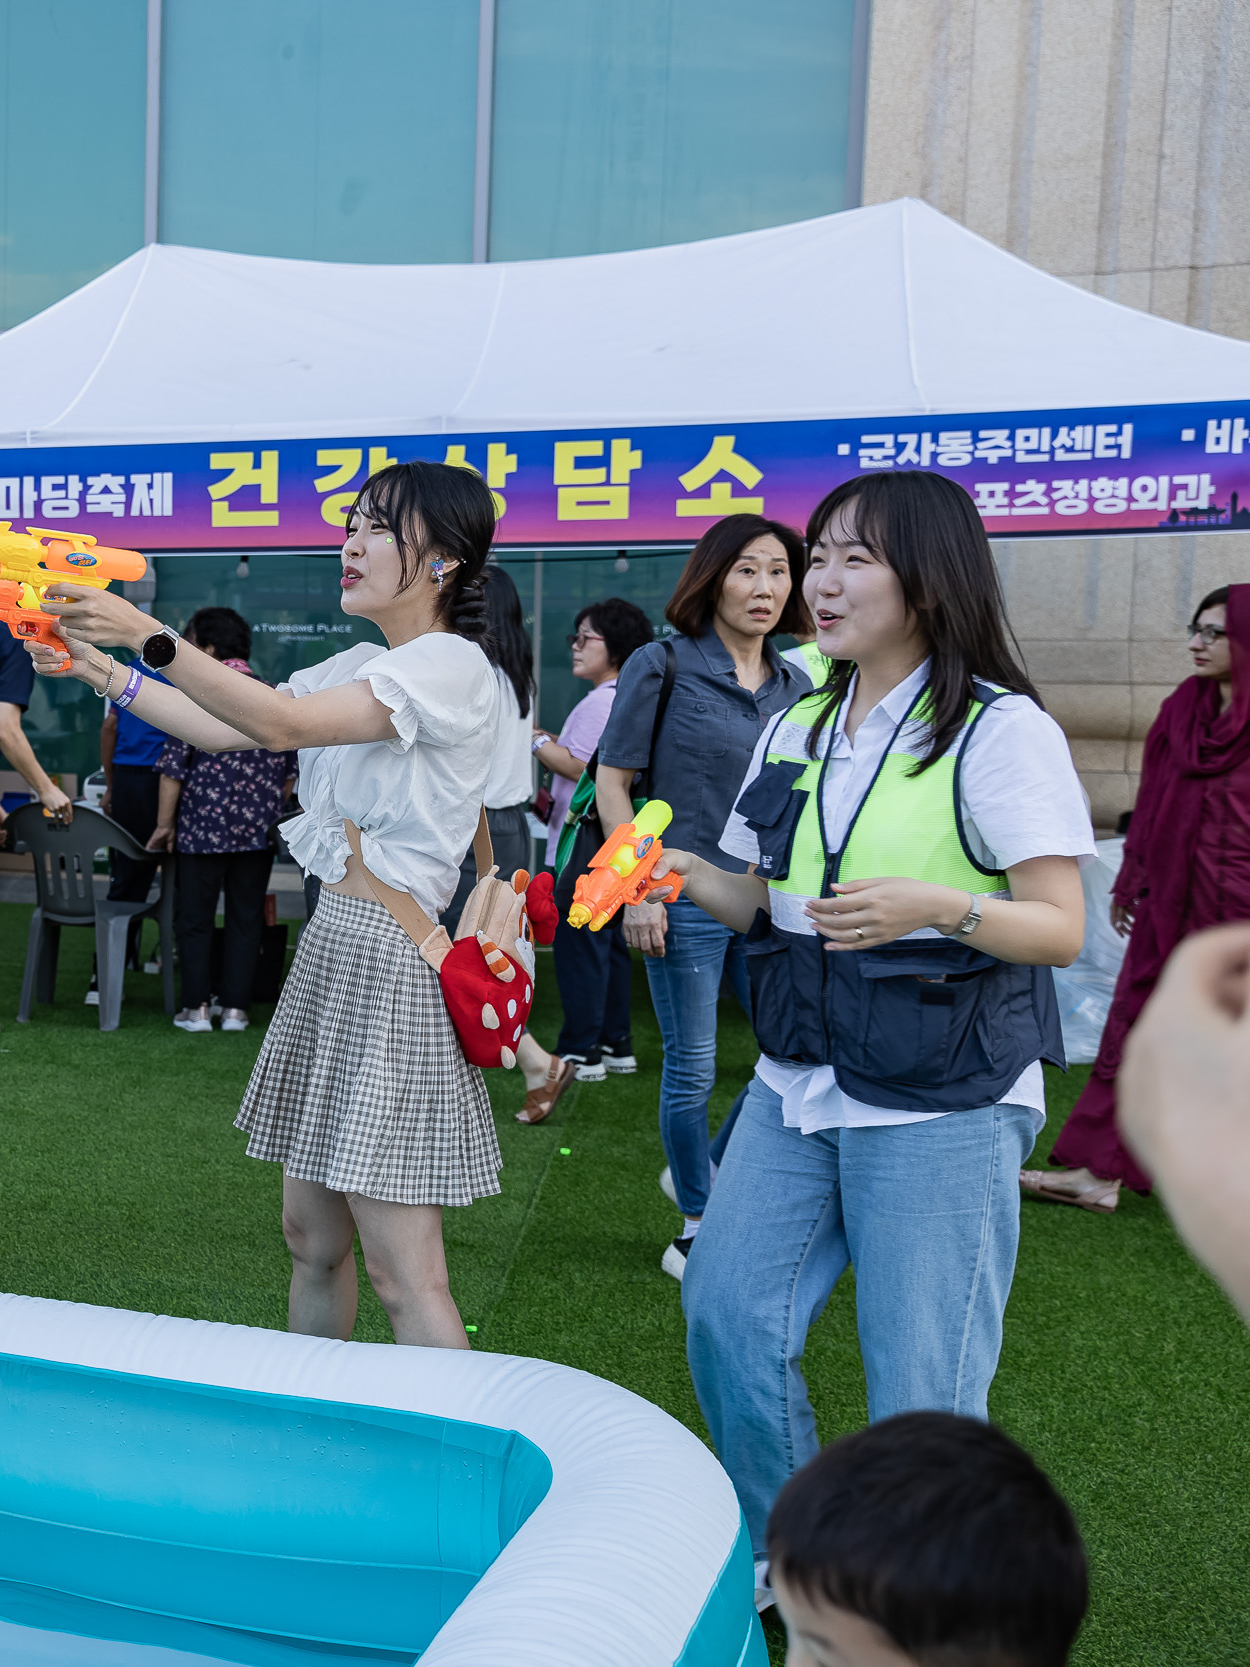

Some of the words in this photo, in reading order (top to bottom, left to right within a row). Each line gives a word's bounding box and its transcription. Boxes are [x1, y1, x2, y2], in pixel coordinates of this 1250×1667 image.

[857, 422, 1134, 469] 군자동주민센터
[206, 434, 765, 529] 건강상담소
[316, 622, 353, 634] PLACE
